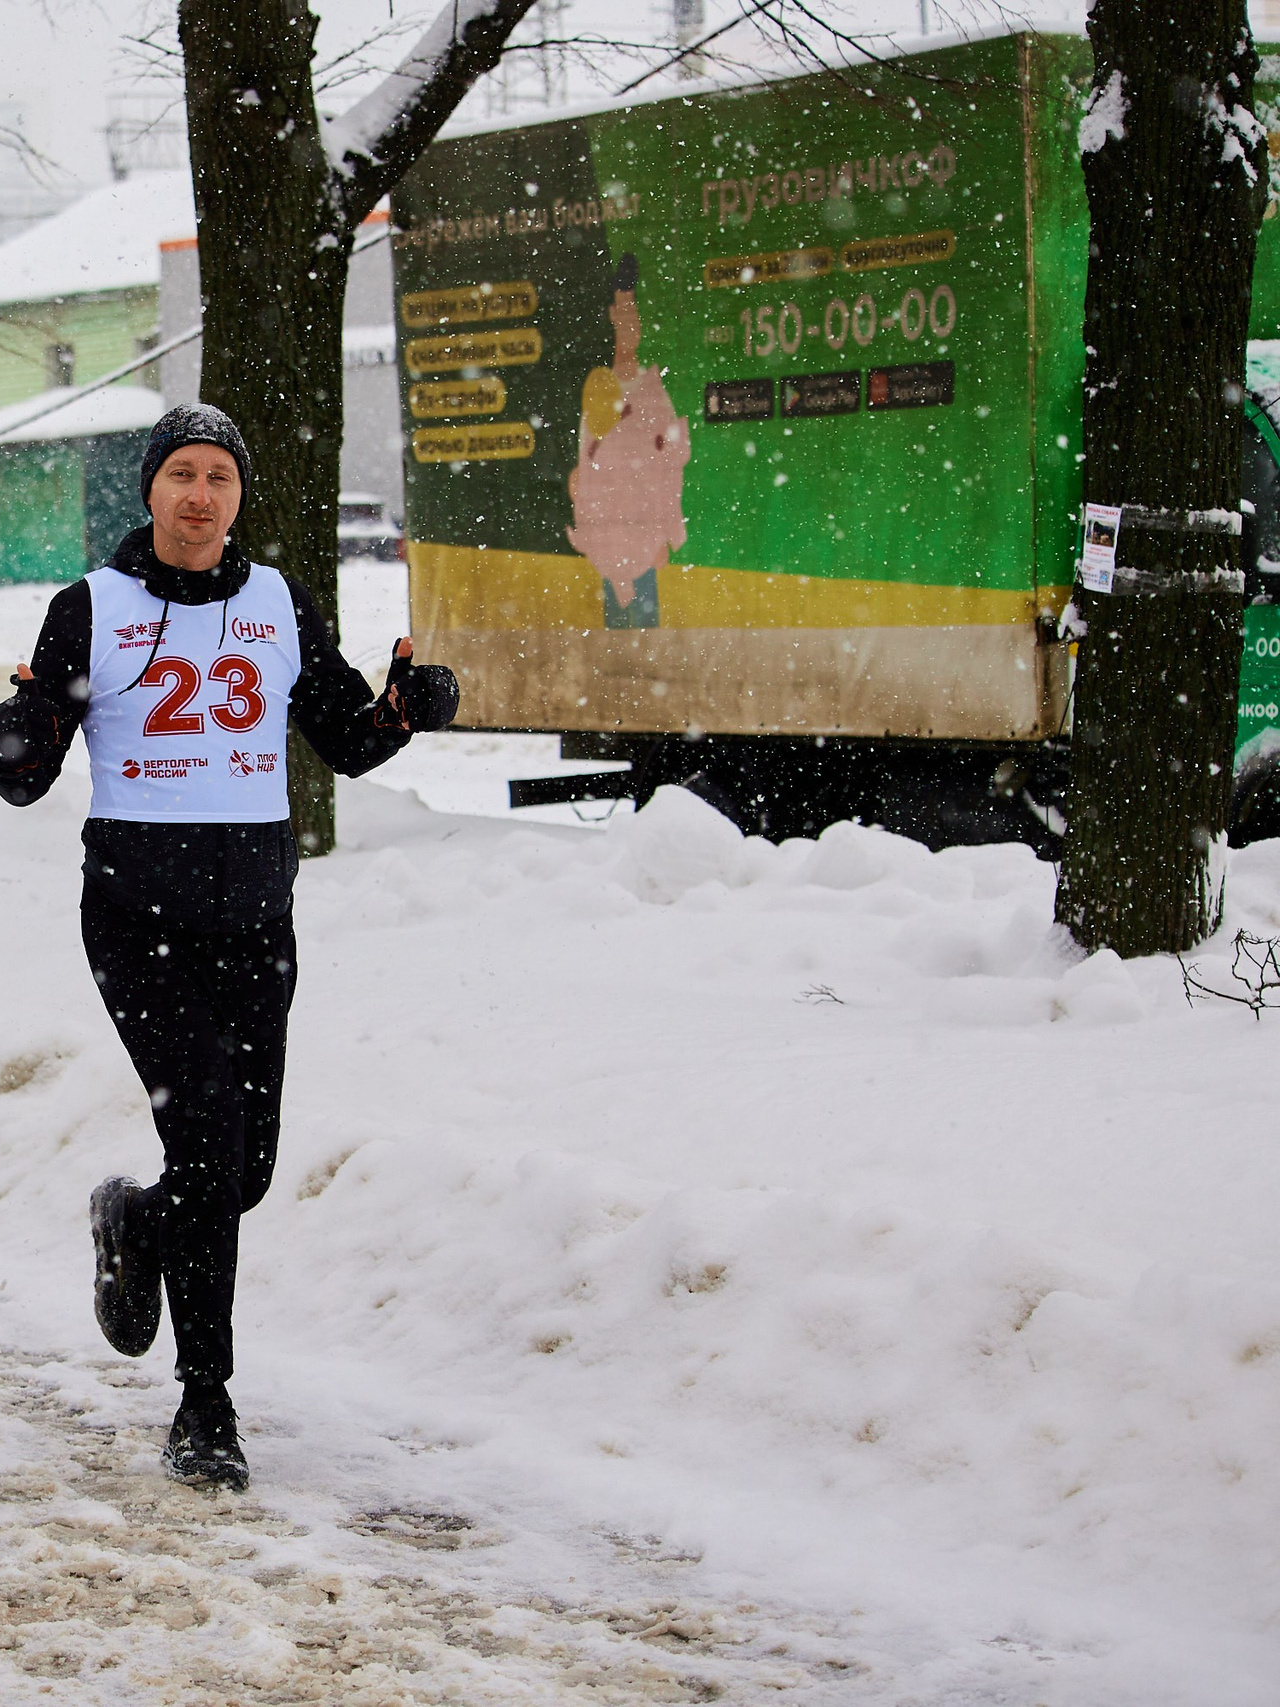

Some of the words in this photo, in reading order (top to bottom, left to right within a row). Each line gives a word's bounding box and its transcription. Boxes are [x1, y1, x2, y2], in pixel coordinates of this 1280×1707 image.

[703, 141, 957, 225] грузовичкоф
[506, 208, 548, 234] ваш
[554, 194, 641, 229] бюджет
[846, 238, 948, 267] круглосуточно
[740, 284, 957, 357] 150-00-00
[139, 654, 267, 737] 23
[144, 758, 208, 769] ВЕРТОЛЕТЫ
[144, 769, 187, 779] РОССИИ
[257, 763, 275, 774] НЦВ
